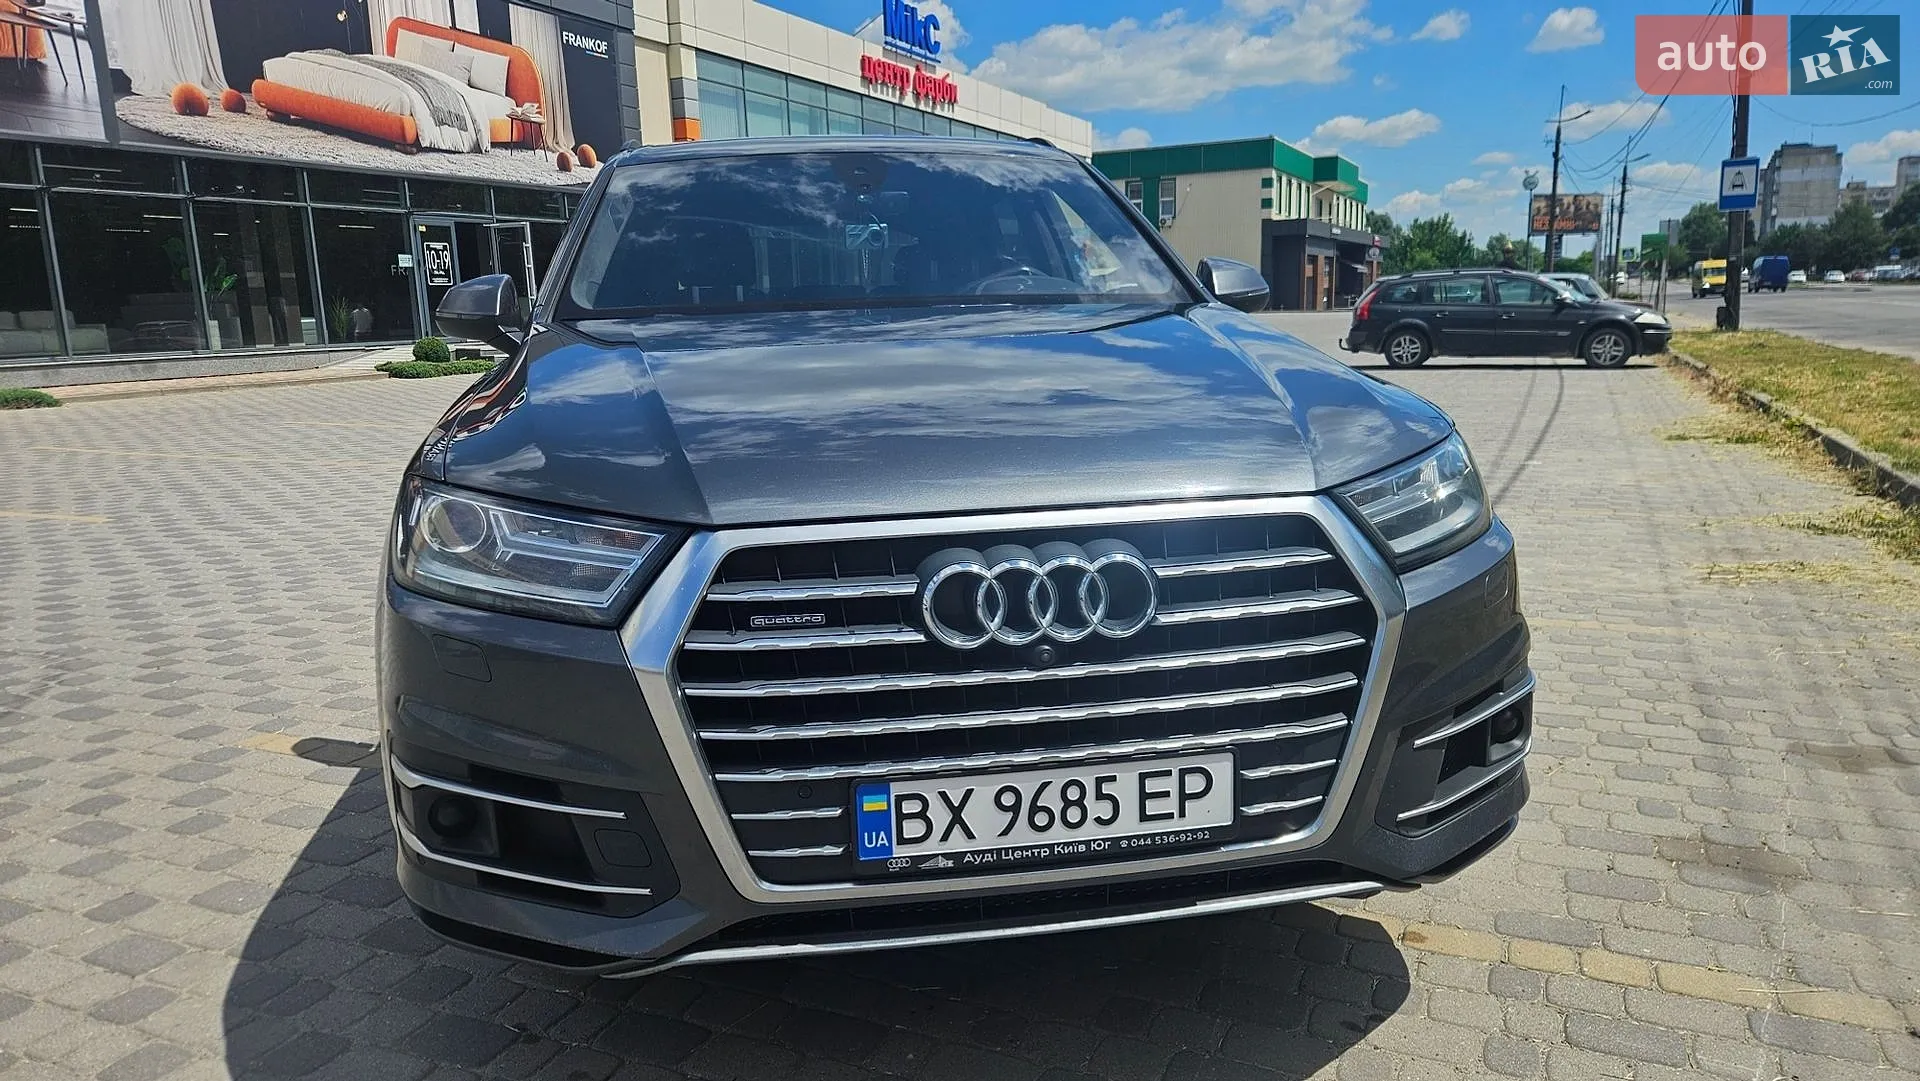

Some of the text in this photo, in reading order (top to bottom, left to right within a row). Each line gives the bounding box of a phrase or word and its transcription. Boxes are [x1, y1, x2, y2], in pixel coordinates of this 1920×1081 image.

[562, 31, 608, 53] FRANKOF
[861, 55, 958, 104] центр фарби
[426, 250, 450, 270] 10-19
[753, 616, 822, 626] quattro
[894, 766, 1214, 846] BX 9685 EP
[863, 831, 889, 848] UA
[1130, 830, 1211, 848] 044 536-92-92
[962, 851, 998, 866] Ауді
[1001, 846, 1051, 861] Центр
[1054, 841, 1087, 856] Київ
[1090, 839, 1112, 852] Юг
